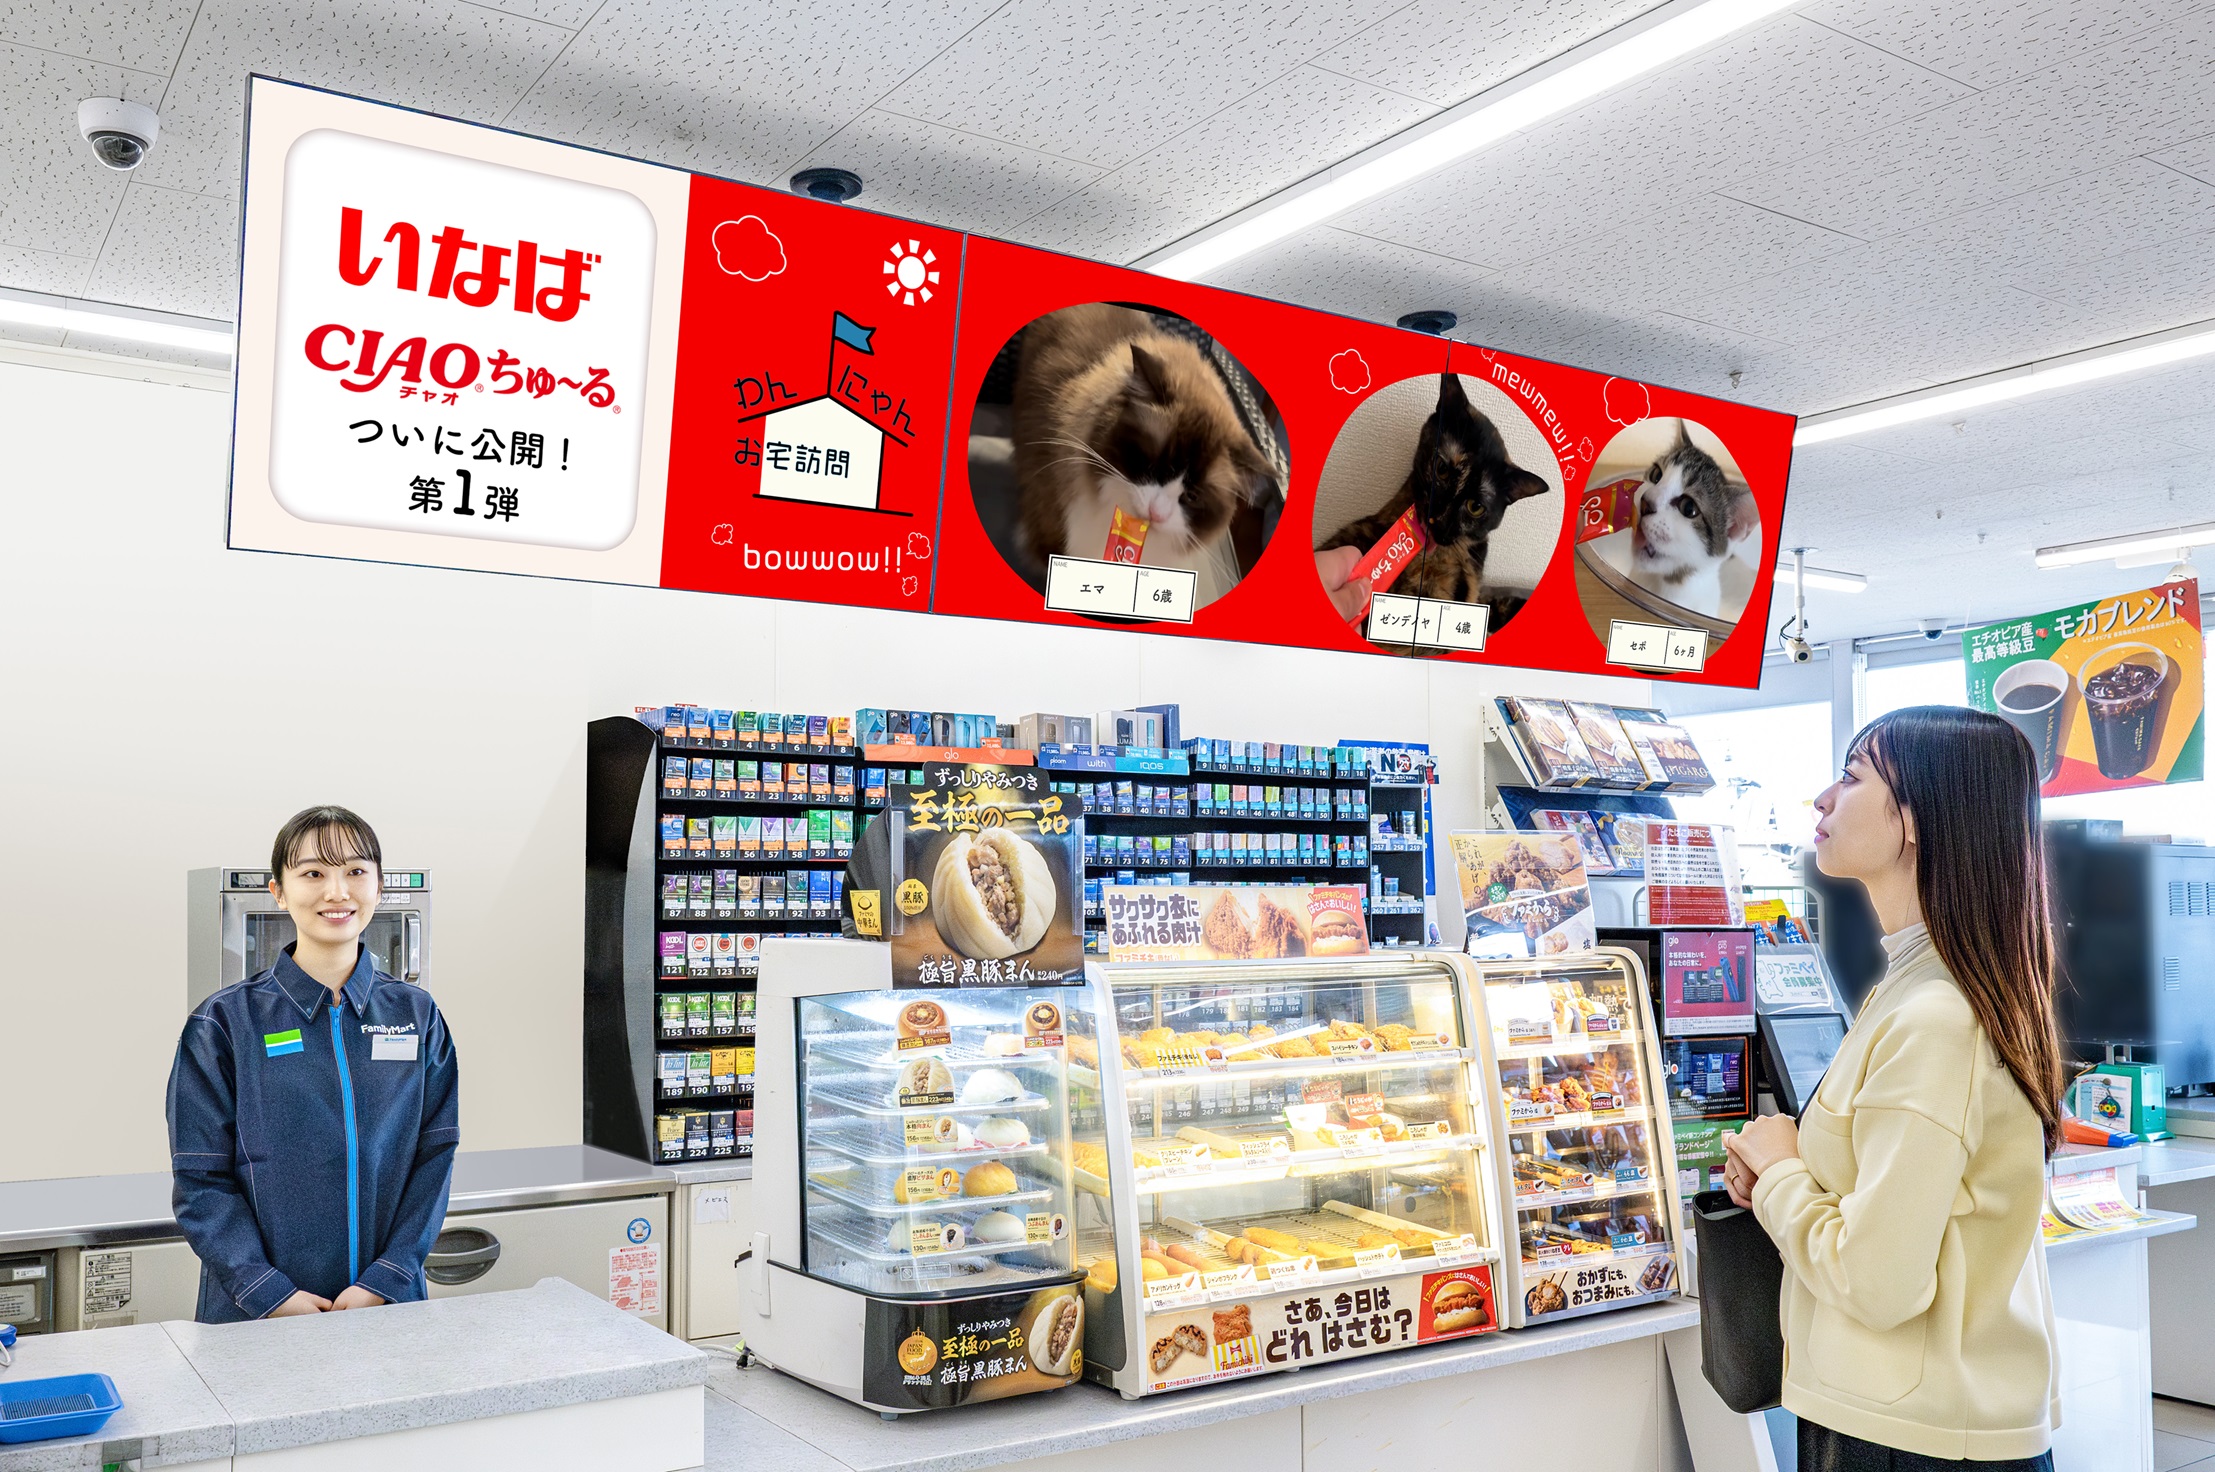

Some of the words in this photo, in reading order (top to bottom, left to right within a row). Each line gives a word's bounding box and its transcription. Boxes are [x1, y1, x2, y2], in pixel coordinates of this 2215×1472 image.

[339, 206, 602, 322] いなば
[304, 324, 480, 394] CIAO
[399, 385, 459, 406] チャオ
[733, 370, 797, 410] わん
[837, 364, 915, 437] にゃん
[1491, 362, 1576, 464] mewmew!!
[348, 418, 571, 472] ついに公開！
[733, 437, 850, 479] お宅訪問
[408, 469, 521, 521] 第1弾
[743, 544, 901, 573] bowwow!!
[1080, 583, 1104, 594] エマ
[1152, 589, 1173, 604] 6歳
[2054, 587, 2185, 640] モカブレンド
[1455, 621, 1471, 636] 4歳
[1972, 621, 2034, 647] エチオピア産
[1972, 638, 2035, 663] 最高等級豆
[944, 748, 959, 762] glo
[1050, 756, 1066, 766] ploom
[1140, 762, 1163, 770] IQOS
[935, 768, 1038, 791] ずっしりやみつき
[745, 791, 756, 799] 22
[769, 792, 779, 800] 23
[908, 789, 1070, 836] 至極の一品
[901, 891, 924, 904] 黒豚
[1109, 894, 1200, 921] サクサク衣に
[1112, 921, 1201, 946] あふれる肉汁
[1668, 936, 1679, 947] glo
[918, 958, 1035, 984] 極旨黒豚まん
[1773, 961, 1817, 975] ファミペイ
[361, 1023, 415, 1035] FamilyMart
[666, 1088, 683, 1096] 189
[690, 1149, 707, 1157] 224
[715, 1147, 731, 1155] 225
[1577, 1266, 1627, 1287] おかずにも、
[1284, 1287, 1392, 1325] さあ、今日は
[1573, 1285, 1635, 1306] おつまみにも。
[957, 1318, 1011, 1334] ずっしりやみつき
[941, 1327, 1025, 1361] 至極の一品
[1265, 1327, 1313, 1363] どれ
[940, 1355, 1027, 1385] 極旨黒豚まん
[1220, 1354, 1253, 1371] Famichiki
